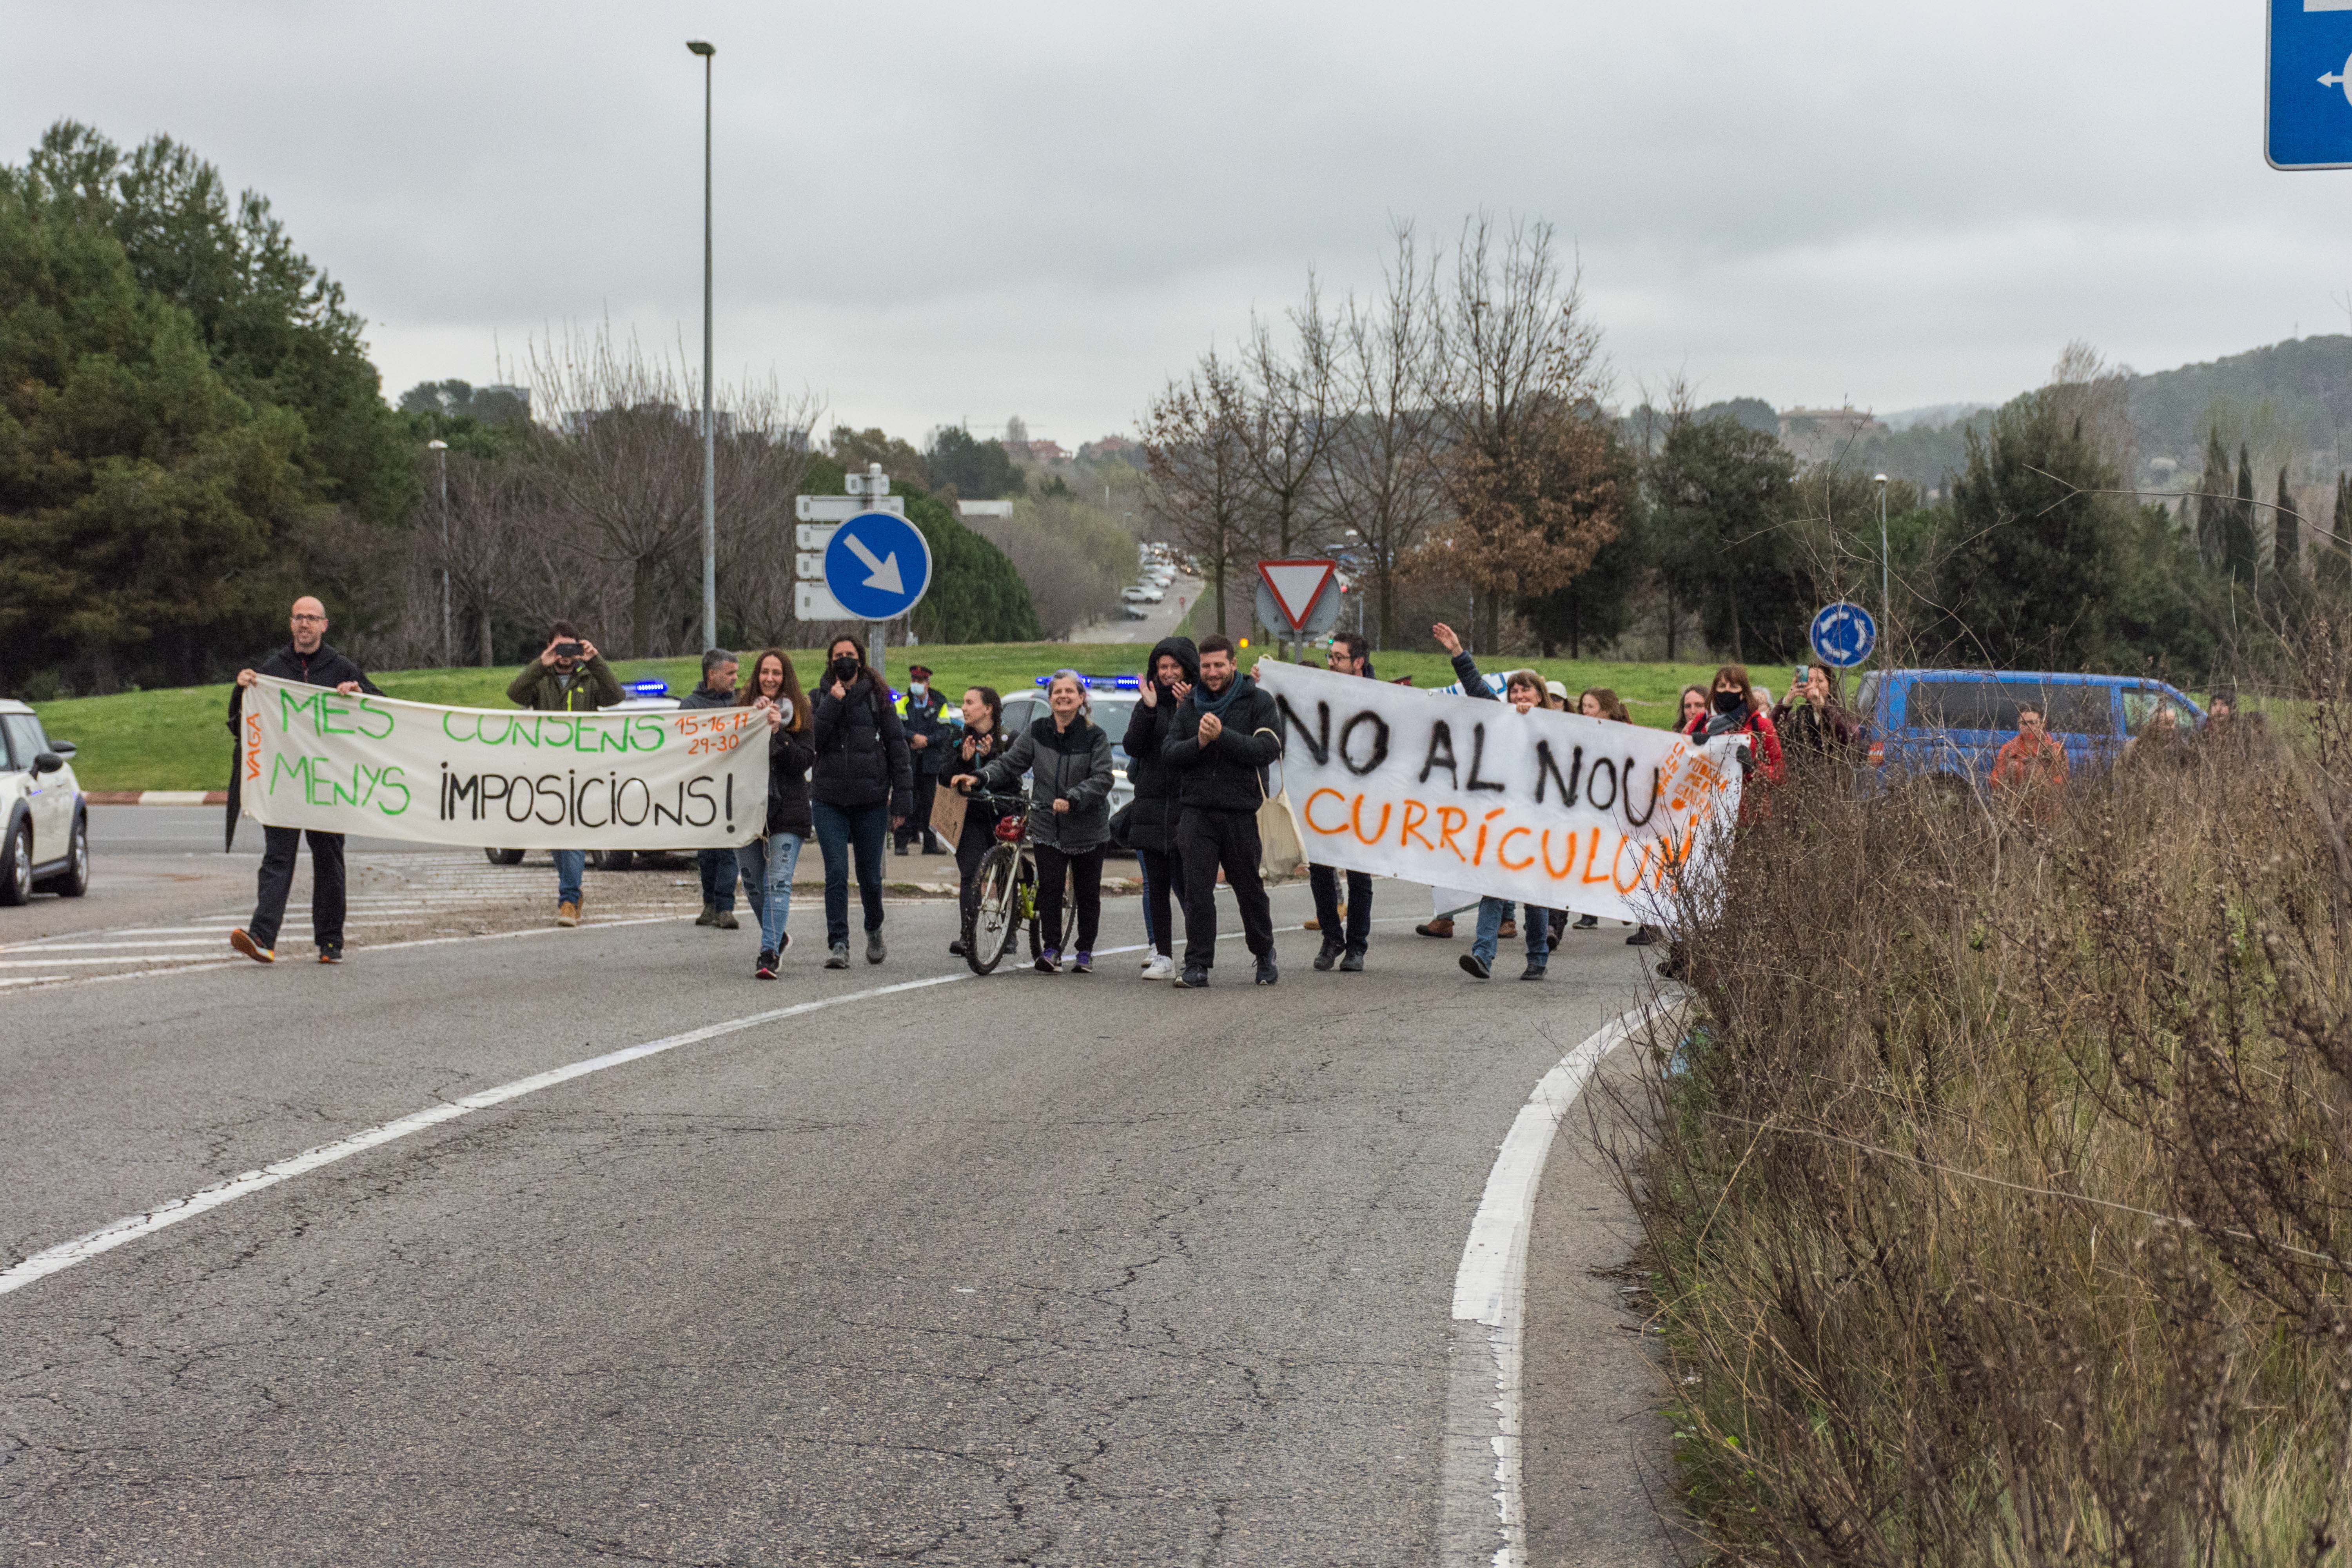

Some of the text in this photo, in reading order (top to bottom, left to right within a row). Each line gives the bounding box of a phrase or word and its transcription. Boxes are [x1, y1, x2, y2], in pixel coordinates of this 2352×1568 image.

[280, 688, 394, 740] MES
[688, 733, 739, 755] 29-30
[246, 713, 261, 781] VAGA
[1275, 693, 1659, 827] NO AL NOU
[270, 752, 410, 815] MENYS
